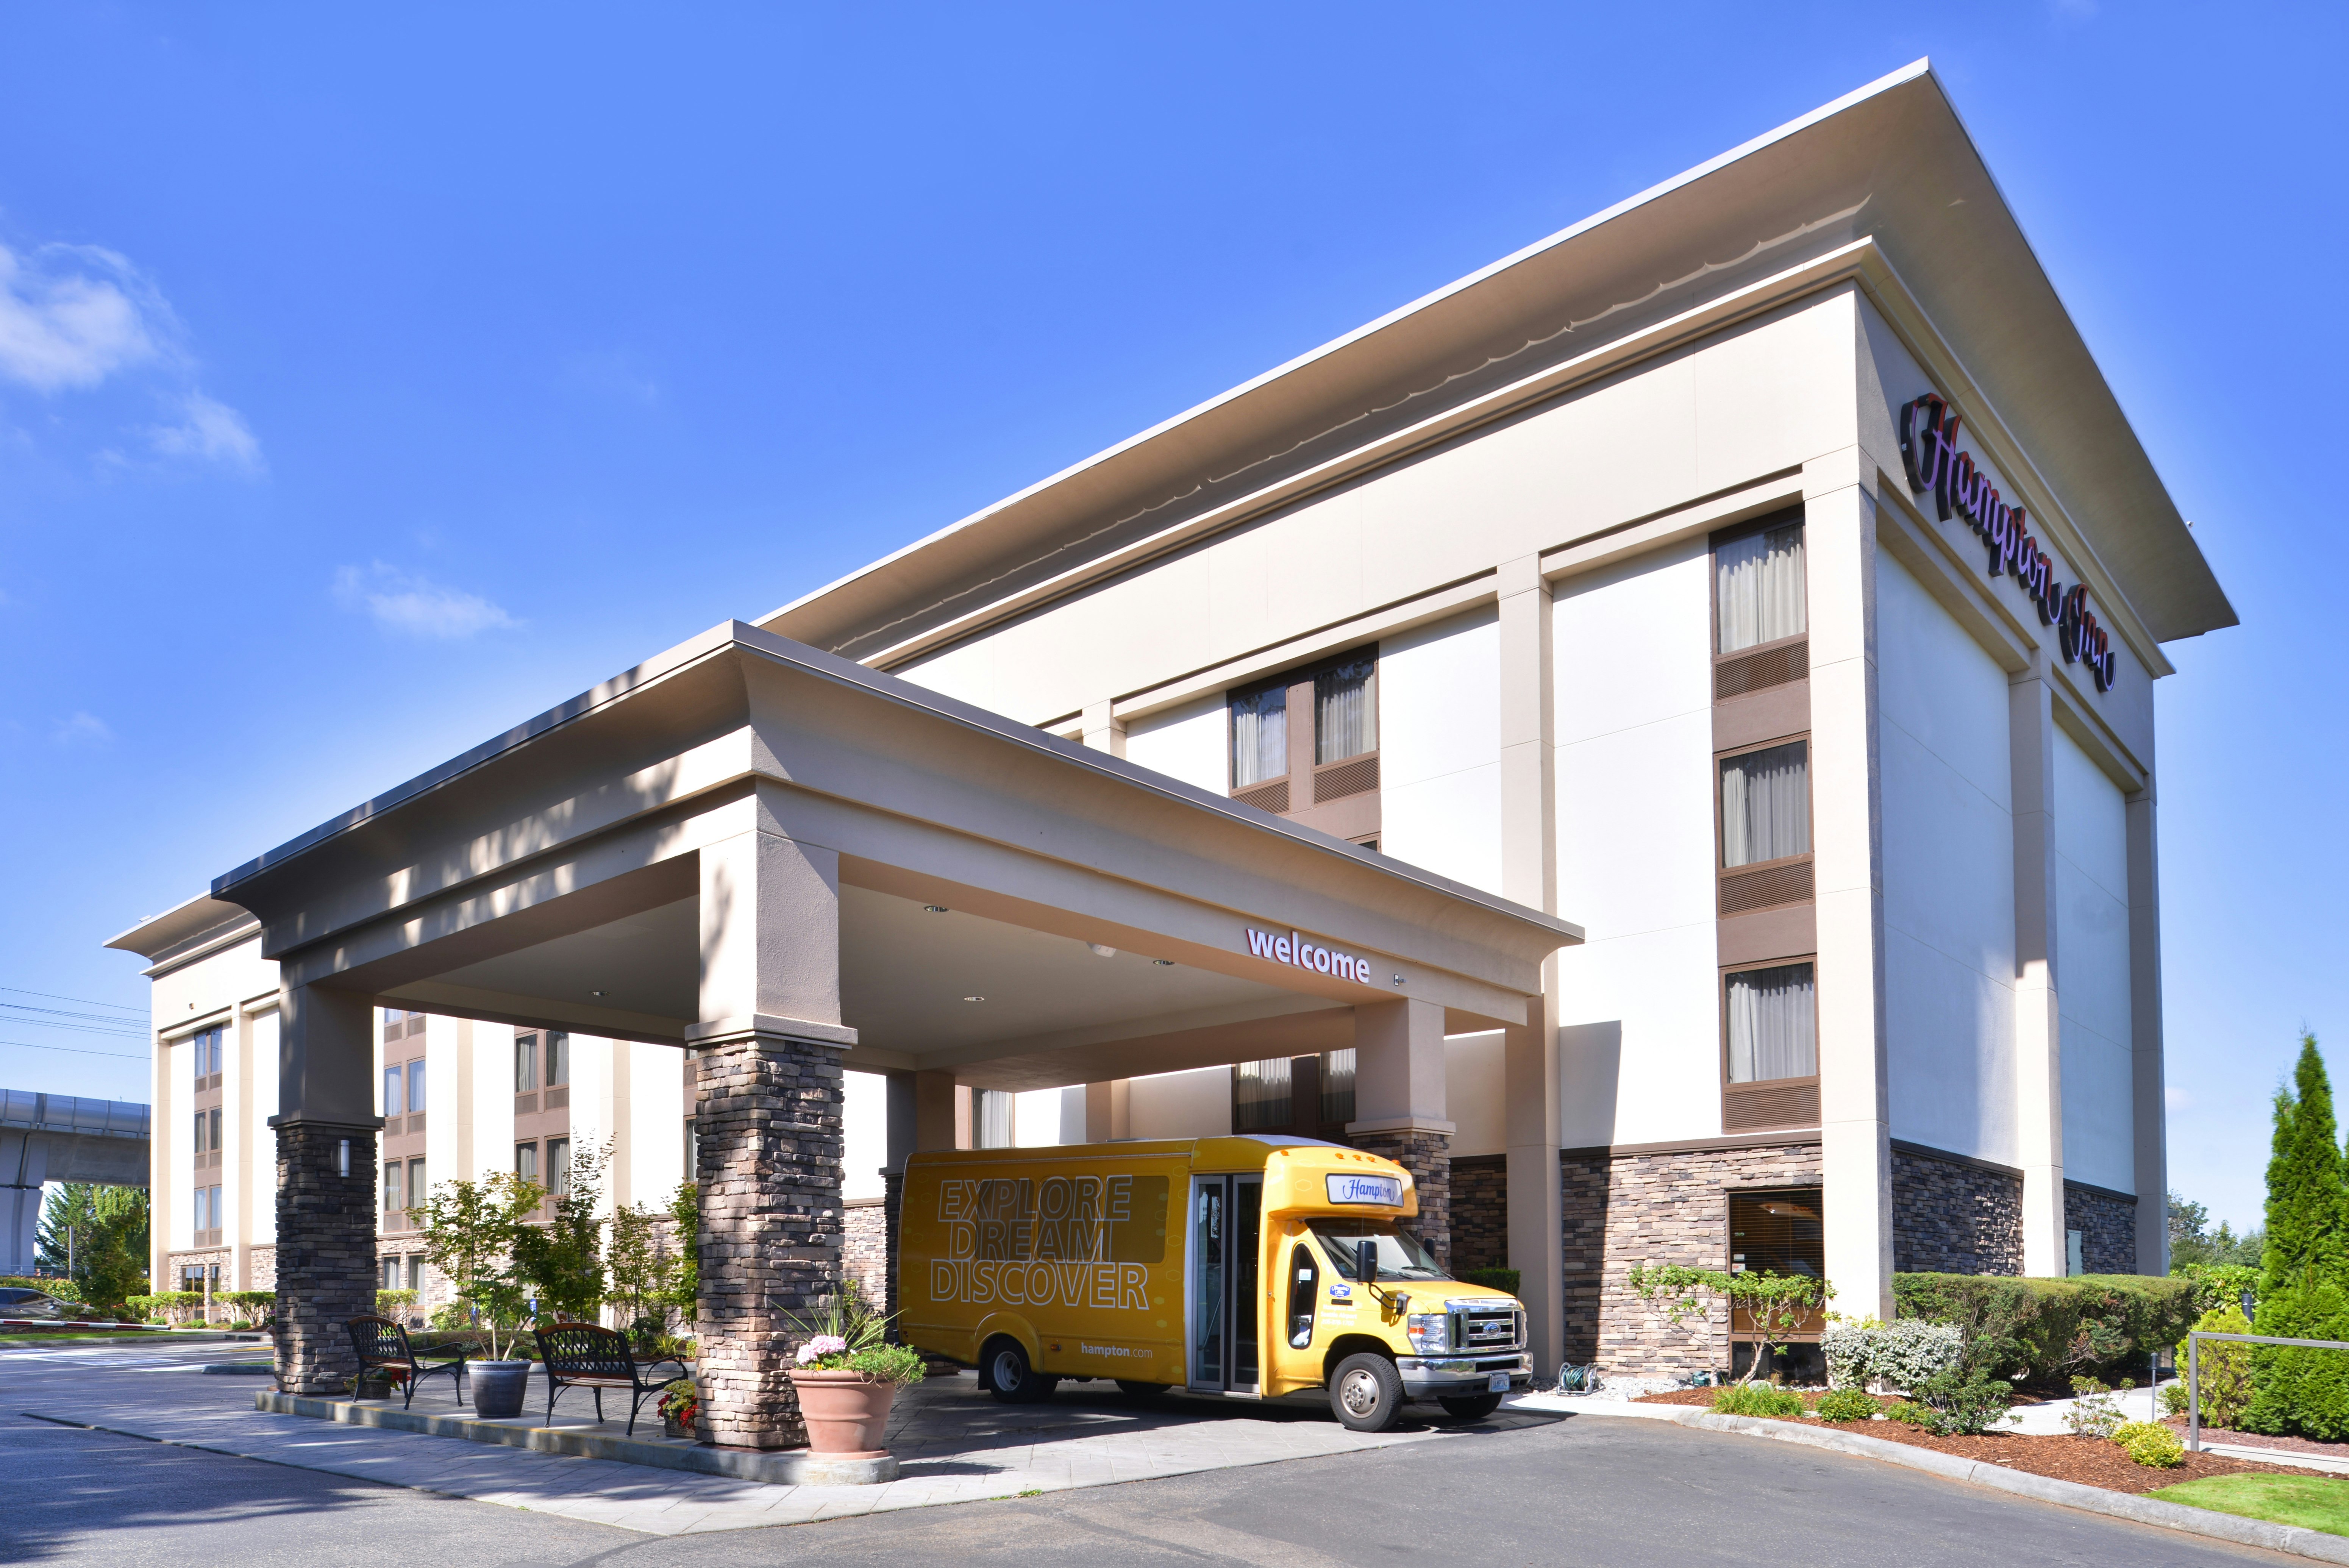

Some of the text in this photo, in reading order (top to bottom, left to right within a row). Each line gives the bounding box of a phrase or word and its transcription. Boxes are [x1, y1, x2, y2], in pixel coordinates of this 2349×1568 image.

[1900, 393, 2116, 693] Hampton Inn
[1246, 929, 1370, 984] welcome
[938, 1174, 1133, 1222] EXPLORE
[1343, 1179, 1395, 1201] Hampton
[949, 1219, 1113, 1264] DREAM
[930, 1259, 1150, 1310] DISCOVER
[1081, 1342, 1153, 1358] hampton.com
